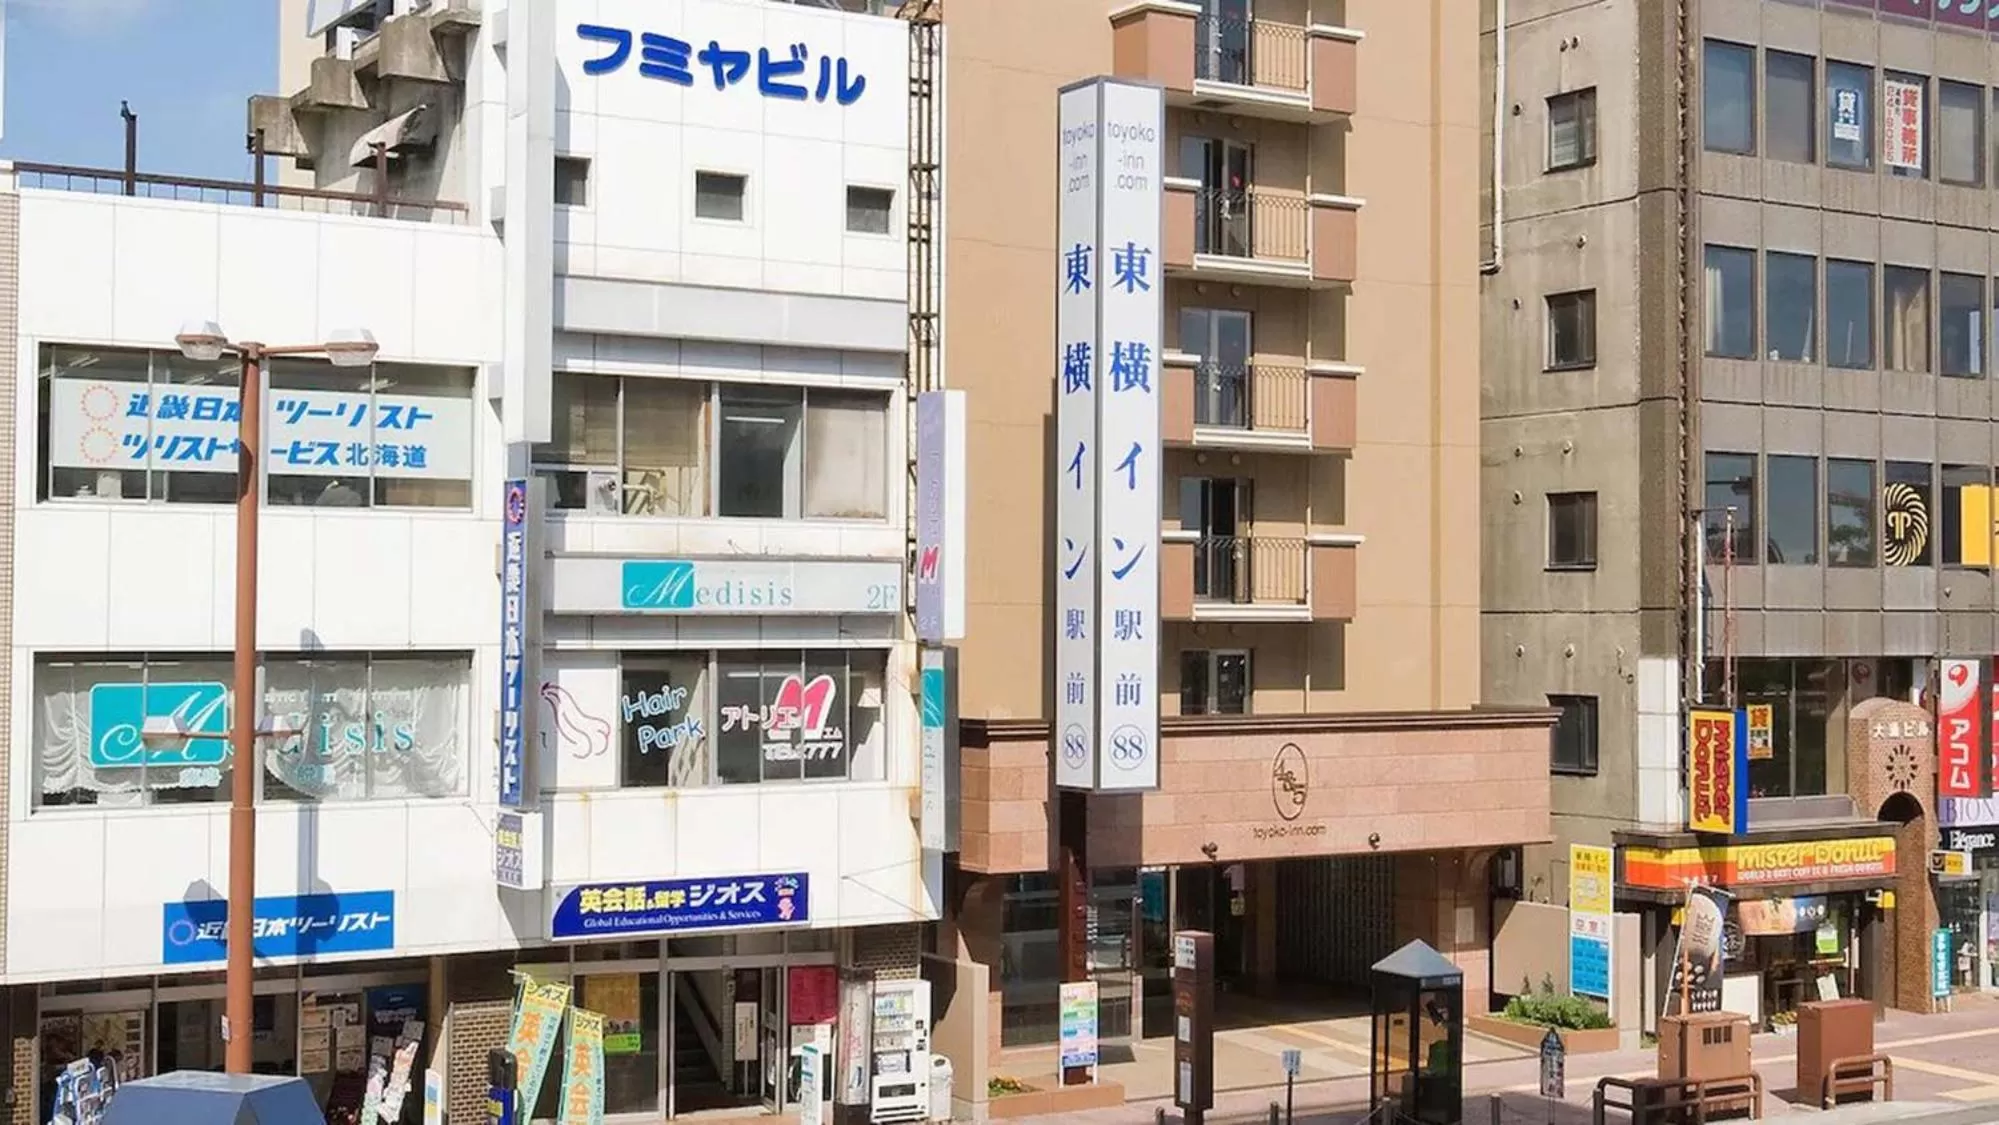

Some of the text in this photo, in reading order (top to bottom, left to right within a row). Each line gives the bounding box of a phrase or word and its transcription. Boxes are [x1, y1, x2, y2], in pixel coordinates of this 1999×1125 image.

[577, 24, 866, 105] フミヤビル
[1107, 121, 1155, 144] toyoko
[621, 684, 688, 723] Hair
[721, 703, 801, 732] アトリエ
[637, 713, 705, 754] Park
[1950, 718, 1970, 789] アコム
[1253, 824, 1327, 840] toyoko-inn.com
